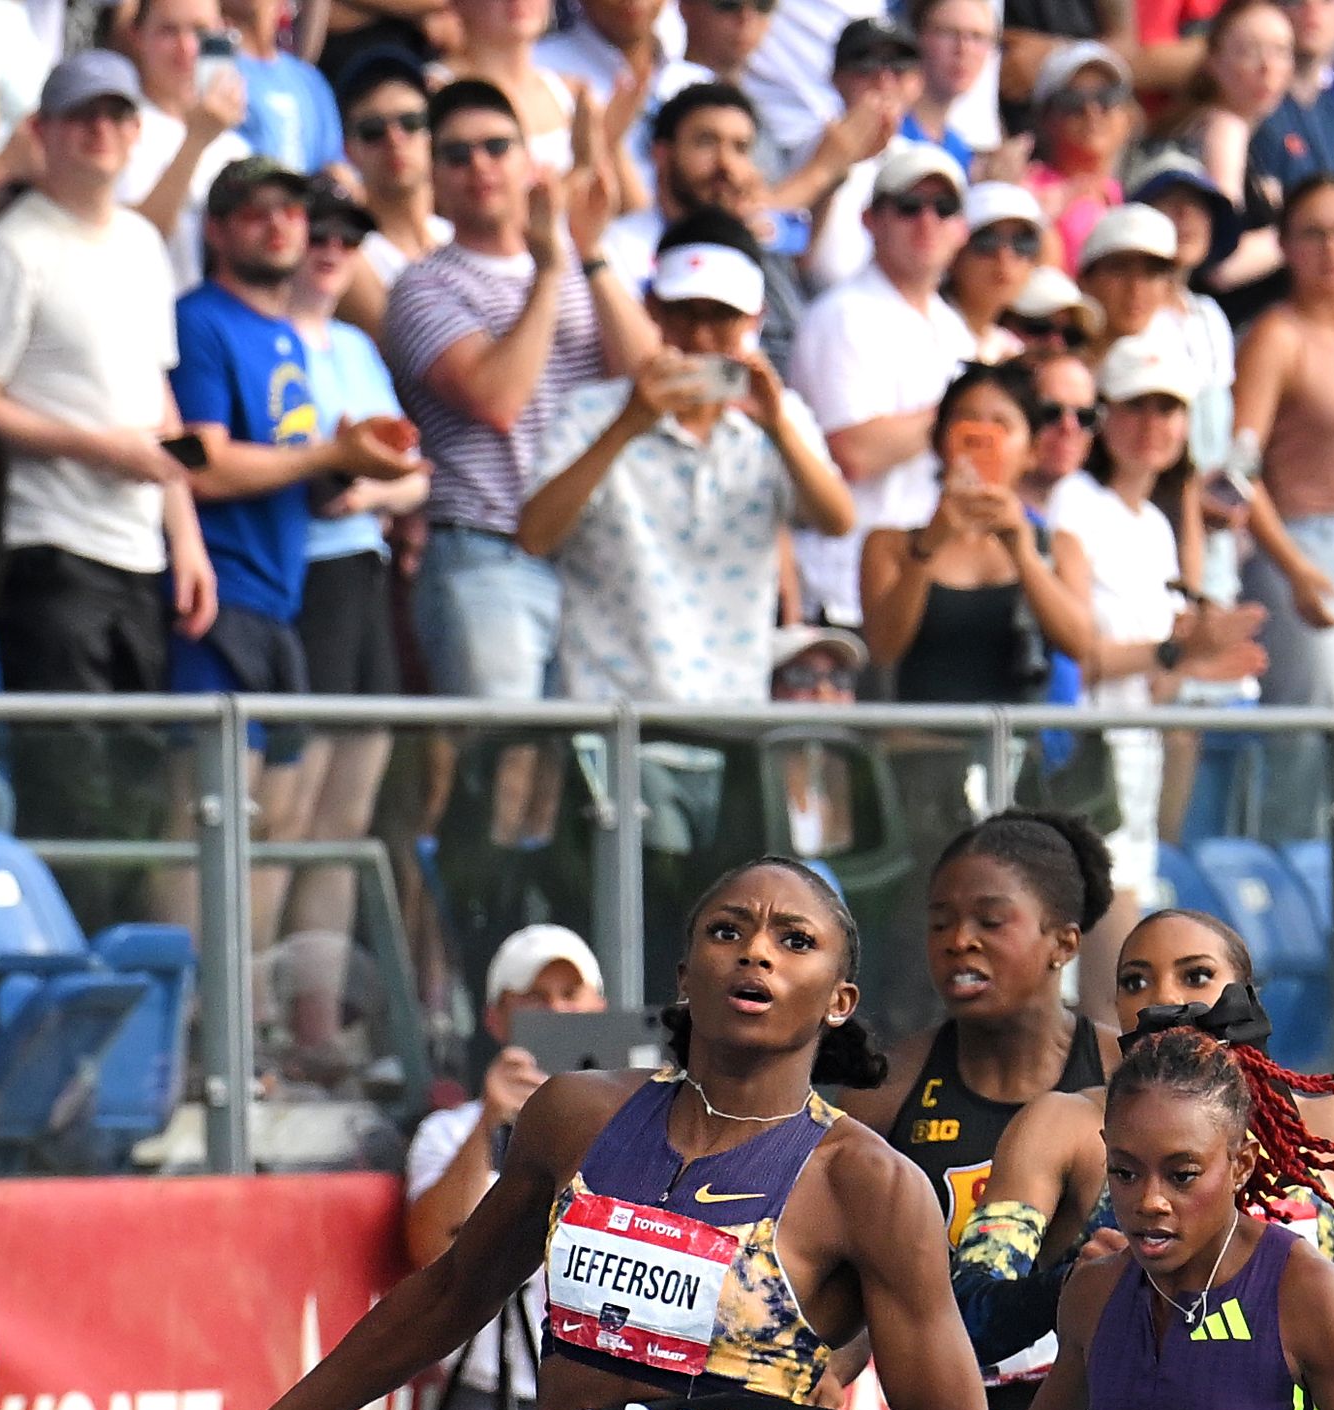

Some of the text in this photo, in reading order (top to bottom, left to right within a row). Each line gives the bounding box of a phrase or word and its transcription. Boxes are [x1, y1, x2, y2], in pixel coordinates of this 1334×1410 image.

[921, 1078, 943, 1108] C
[633, 1217, 682, 1239] TOYOTA
[563, 1244, 701, 1310] JEFFERSON
